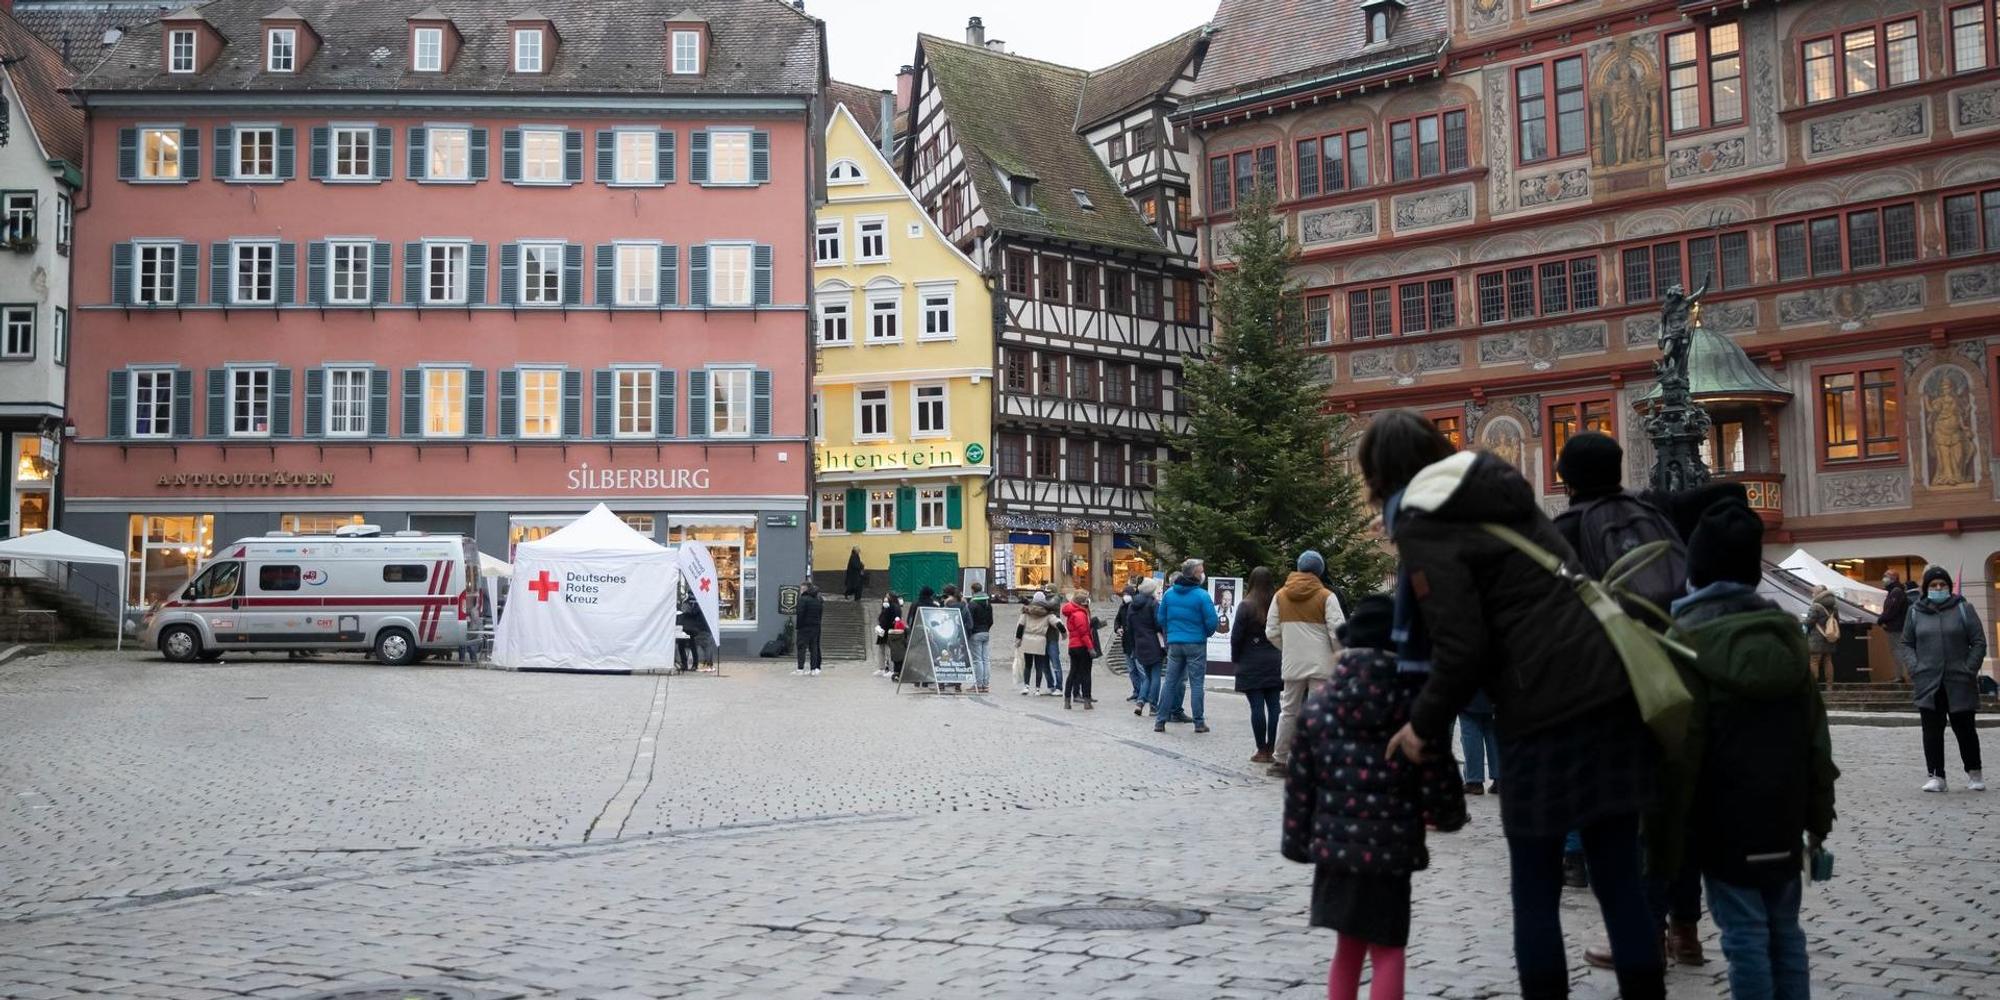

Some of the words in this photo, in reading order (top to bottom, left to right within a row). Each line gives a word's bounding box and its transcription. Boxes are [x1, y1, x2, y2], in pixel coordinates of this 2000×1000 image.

[157, 470, 335, 486] ANTIQUITÄTEN
[566, 571, 627, 584] Deutsches
[566, 583, 599, 593] Rotes
[565, 593, 598, 604] Kreuz
